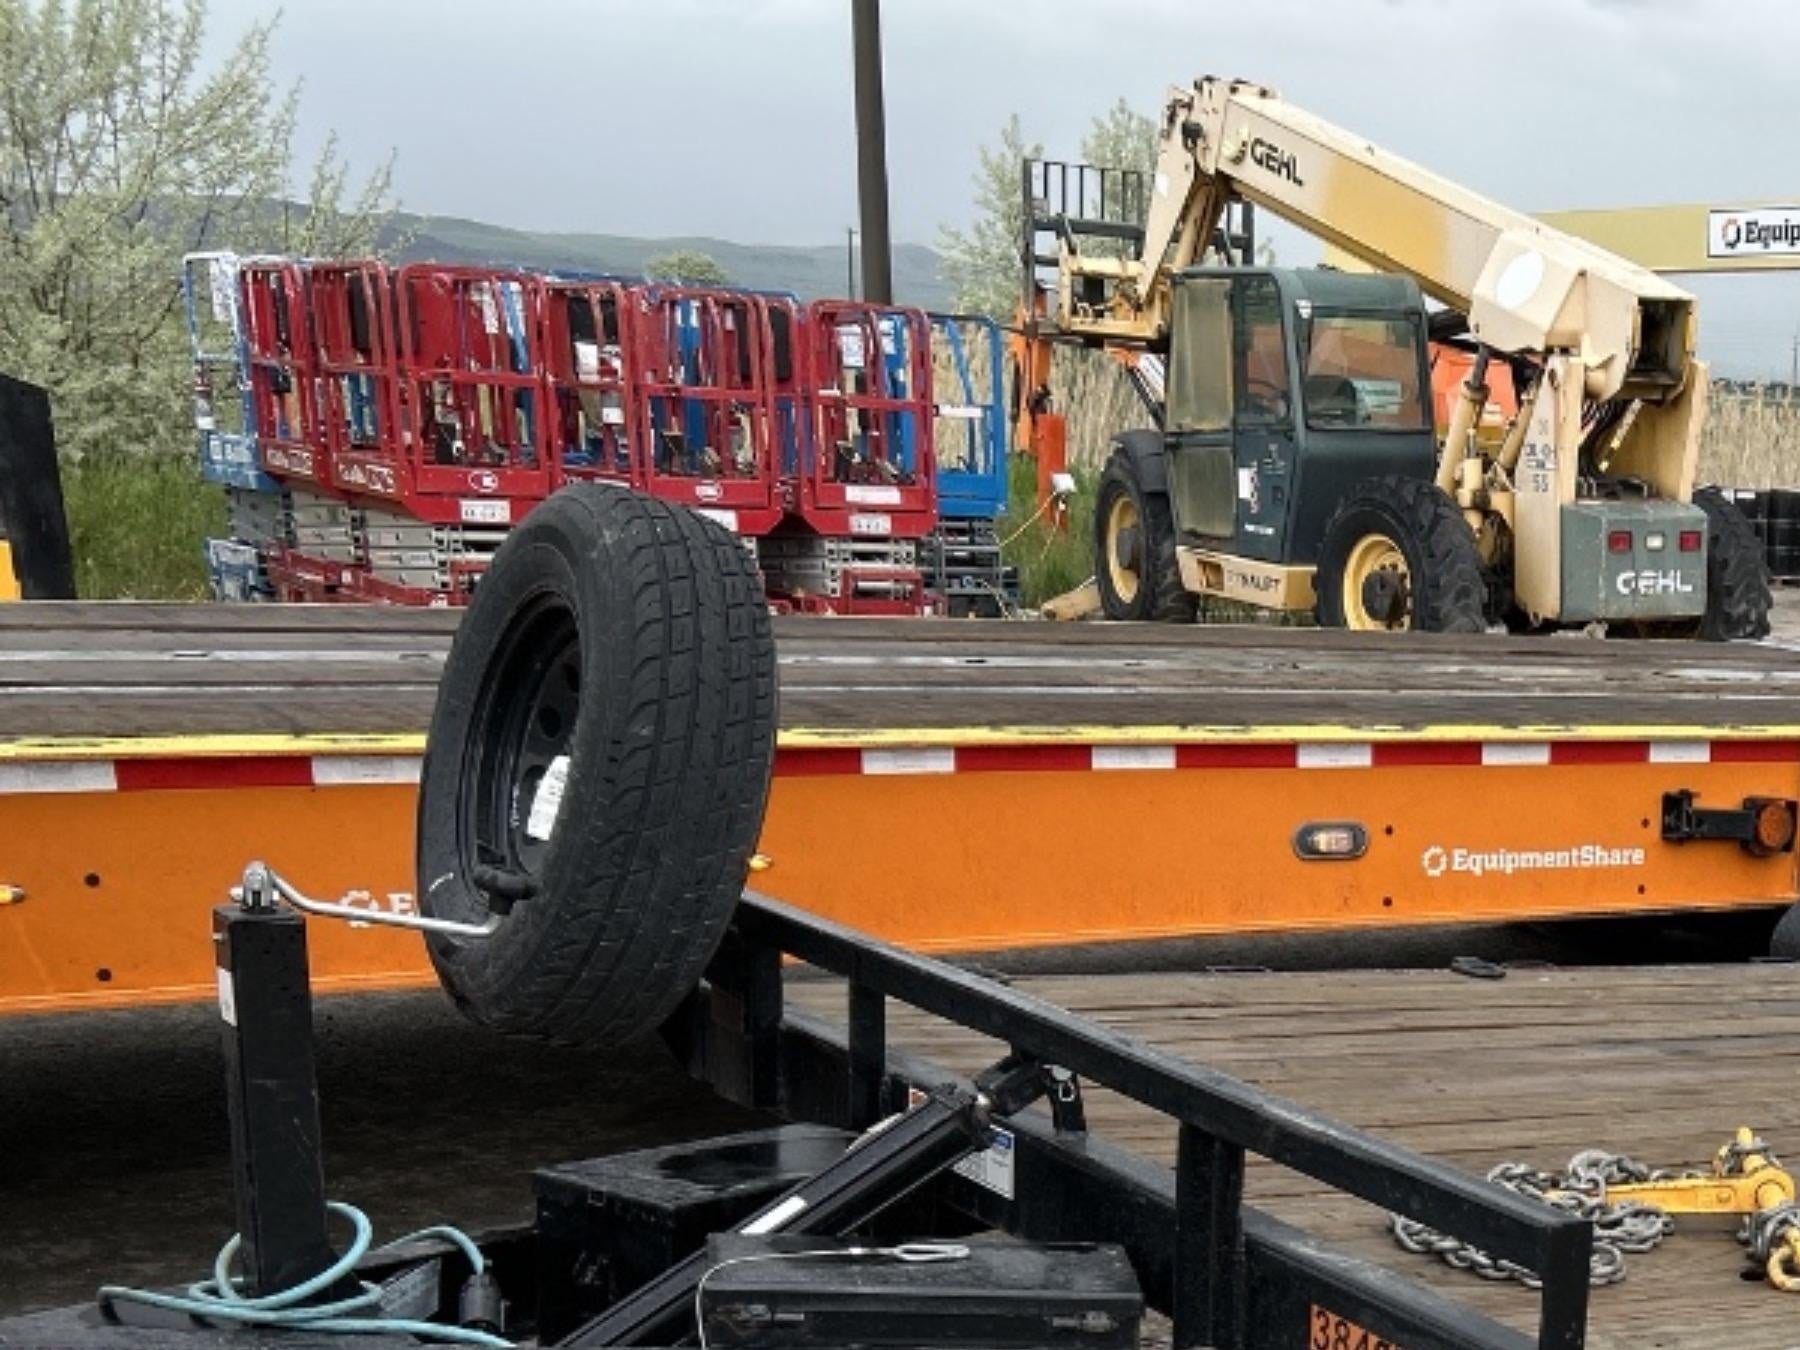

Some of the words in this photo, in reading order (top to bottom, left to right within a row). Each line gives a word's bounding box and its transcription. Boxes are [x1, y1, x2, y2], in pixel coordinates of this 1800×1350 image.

[1250, 137, 1303, 187] GEHL
[1616, 569, 1694, 595] GEHL
[1451, 844, 1645, 877] EquipmentShare
